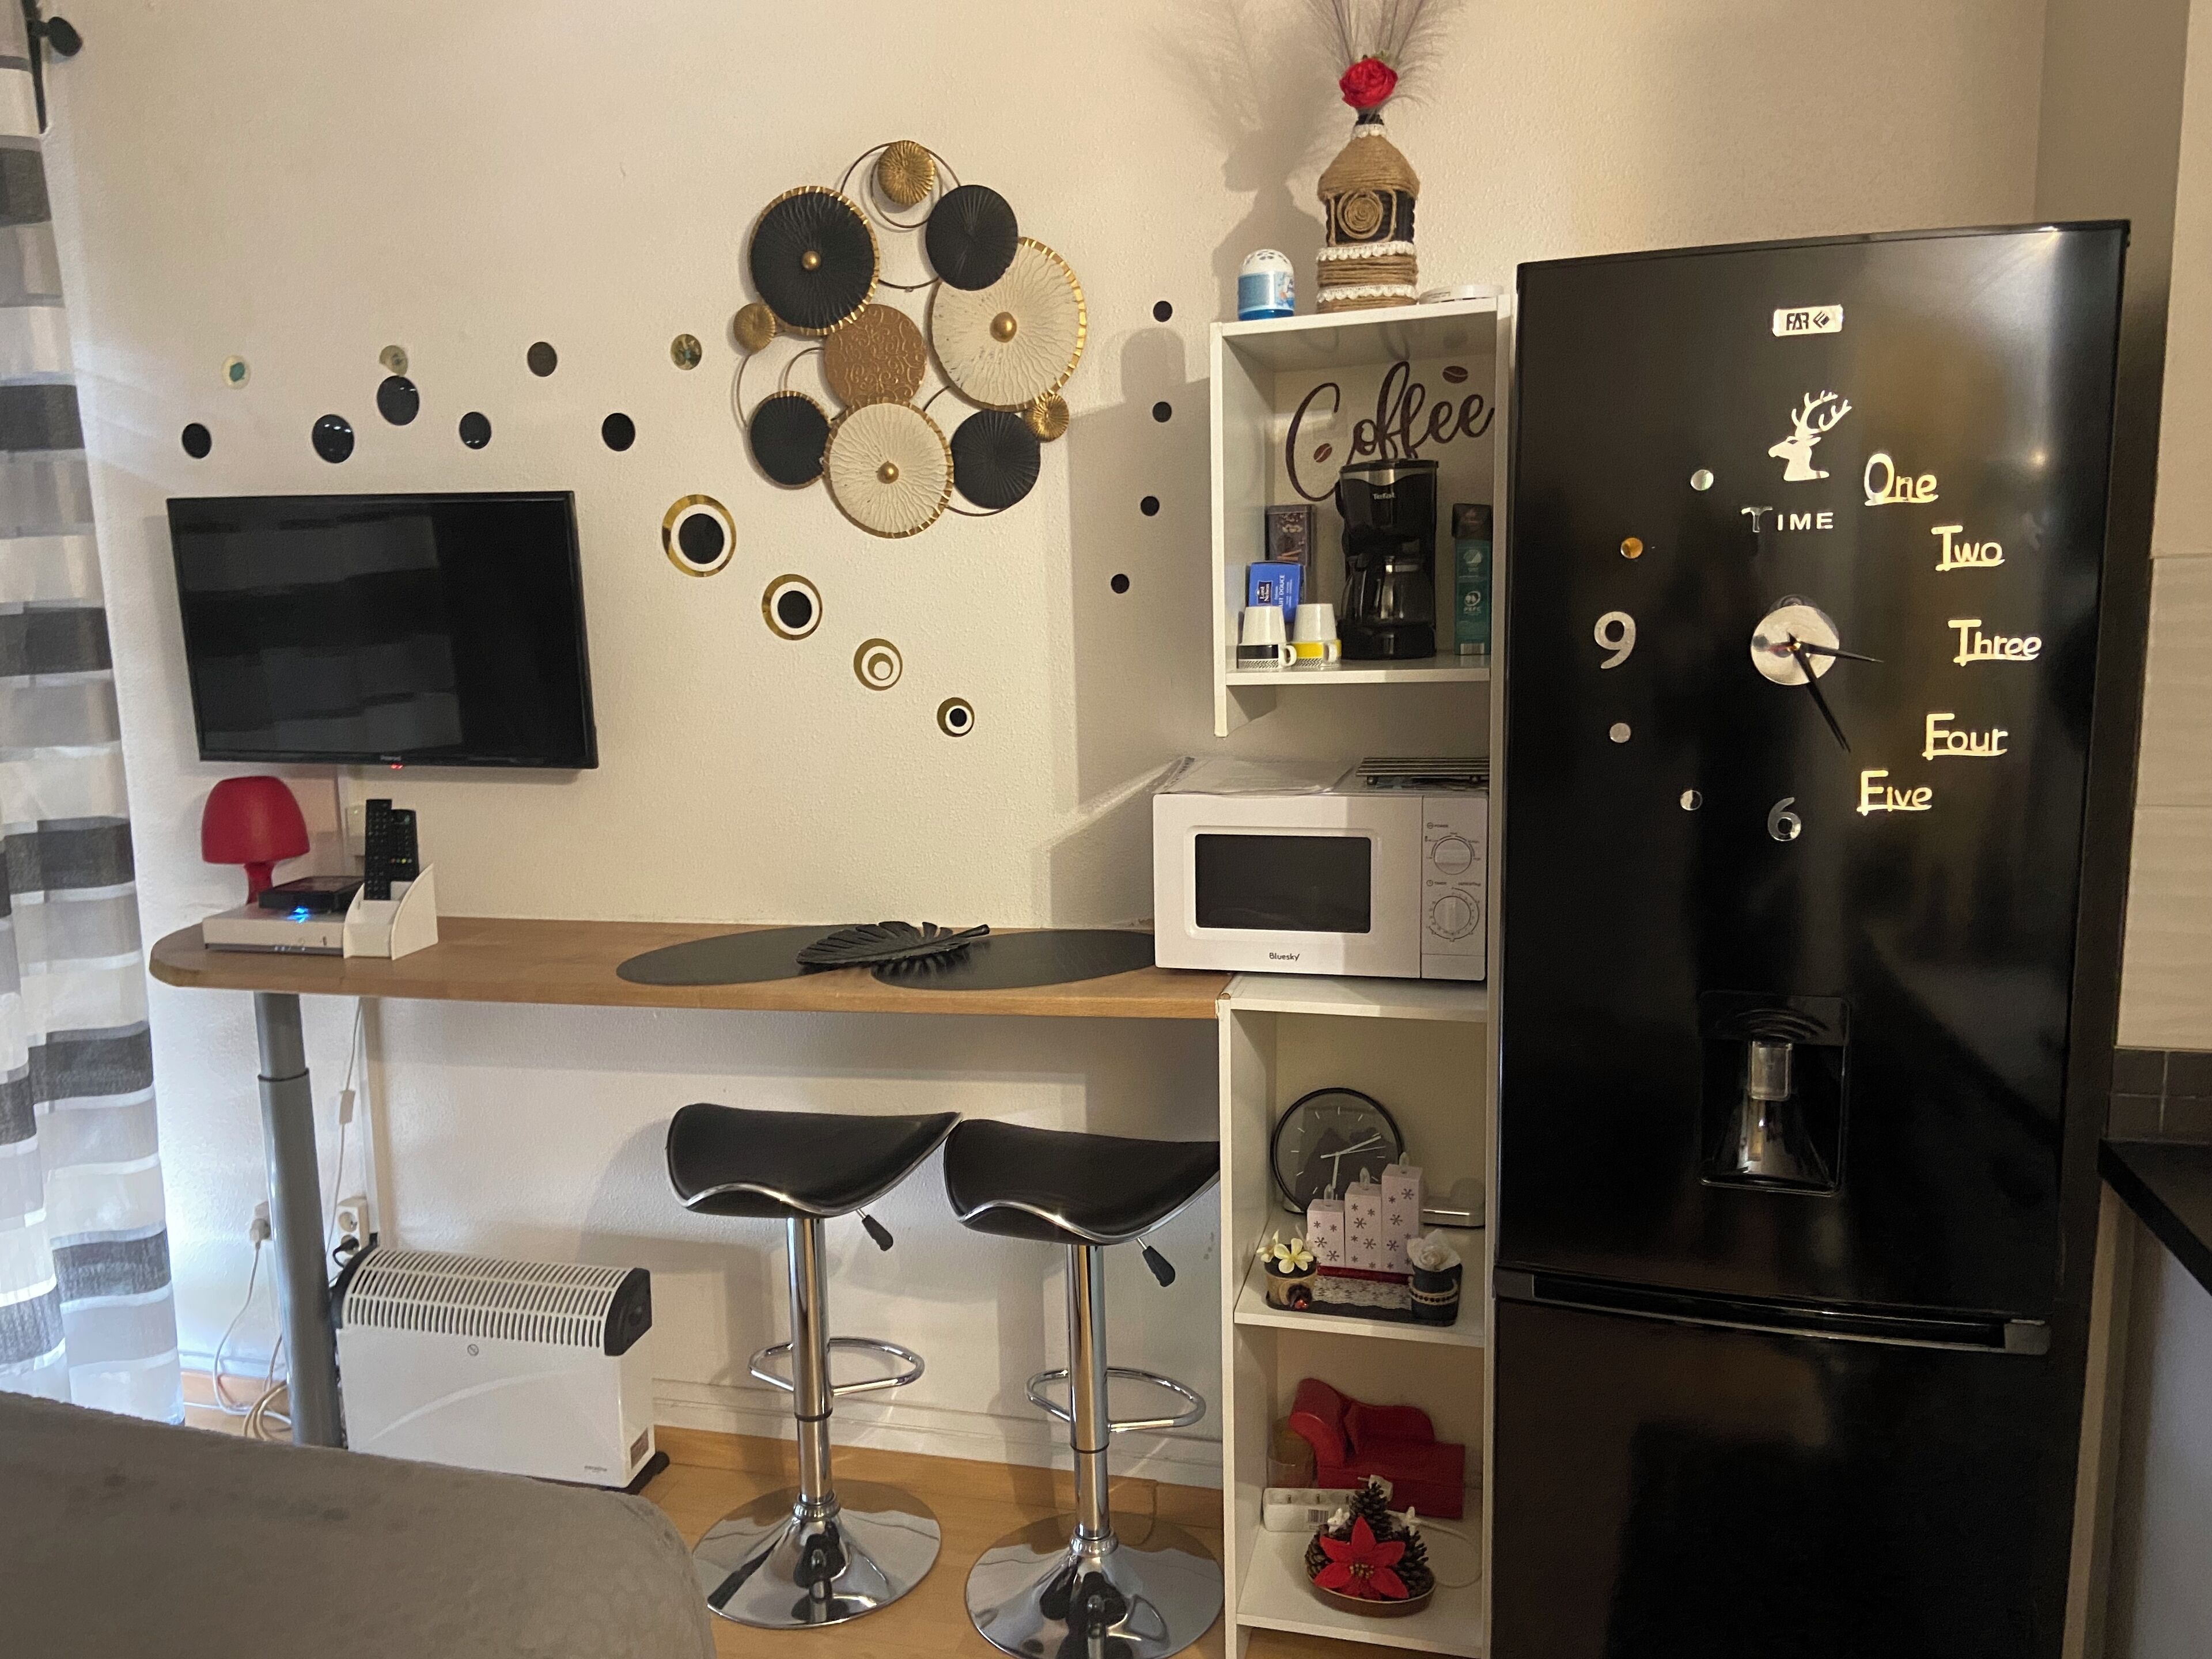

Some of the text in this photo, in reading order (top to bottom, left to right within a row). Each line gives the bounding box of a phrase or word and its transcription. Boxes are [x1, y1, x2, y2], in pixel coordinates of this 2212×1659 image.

[1786, 312, 1809, 331] FAR
[1285, 361, 1495, 502] Coffee
[1863, 453, 1938, 506] One
[1741, 506, 1834, 533] TIME
[1931, 525, 2005, 571] Two
[1594, 611, 1637, 669] 9
[1948, 619, 2042, 666] Three
[1922, 713, 2008, 760] Four
[1857, 770, 1933, 816] Five
[1767, 797, 1802, 842] 6
[1269, 952, 1300, 961] Bluesky
